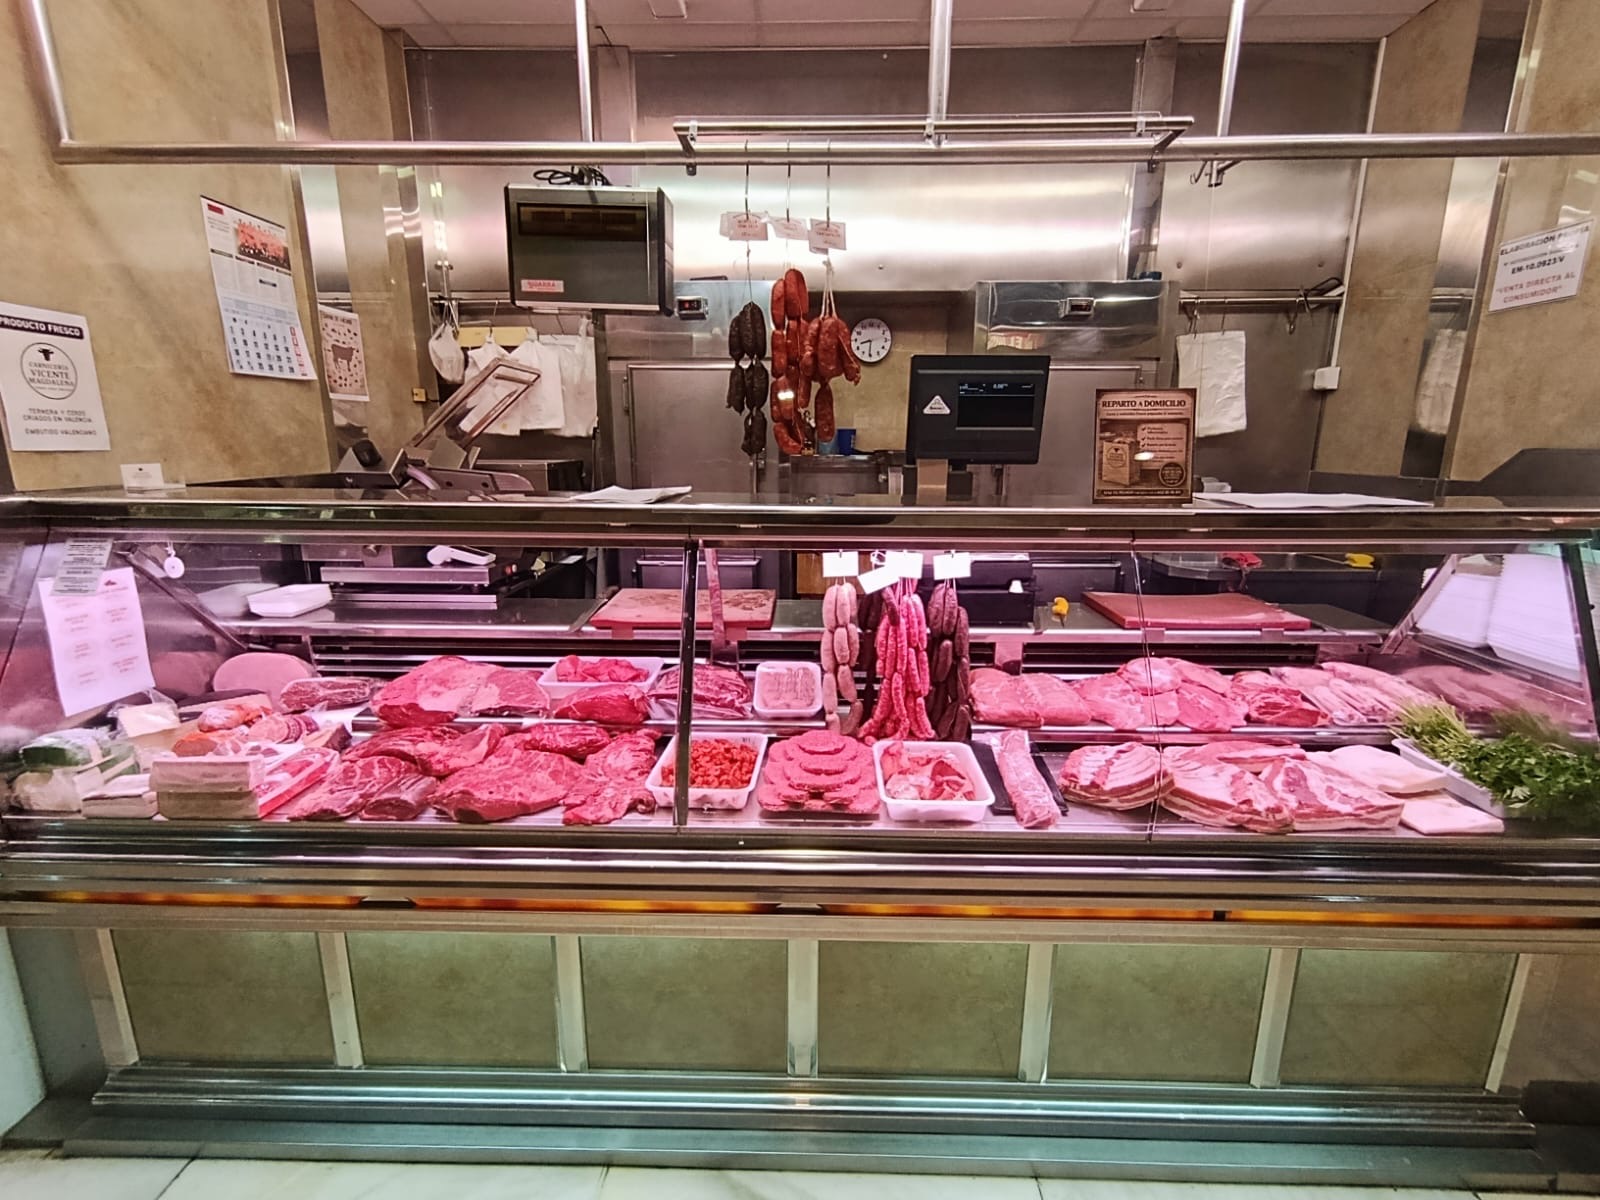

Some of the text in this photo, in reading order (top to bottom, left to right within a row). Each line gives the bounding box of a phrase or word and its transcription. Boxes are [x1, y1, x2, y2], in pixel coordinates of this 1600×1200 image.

[48, 324, 80, 336] FRESCO
[30, 369, 70, 380] VICENTE
[28, 377, 75, 386] MAGDALENA
[1102, 400, 1136, 408] REPARTO
[1144, 400, 1186, 408] DOMICILIO
